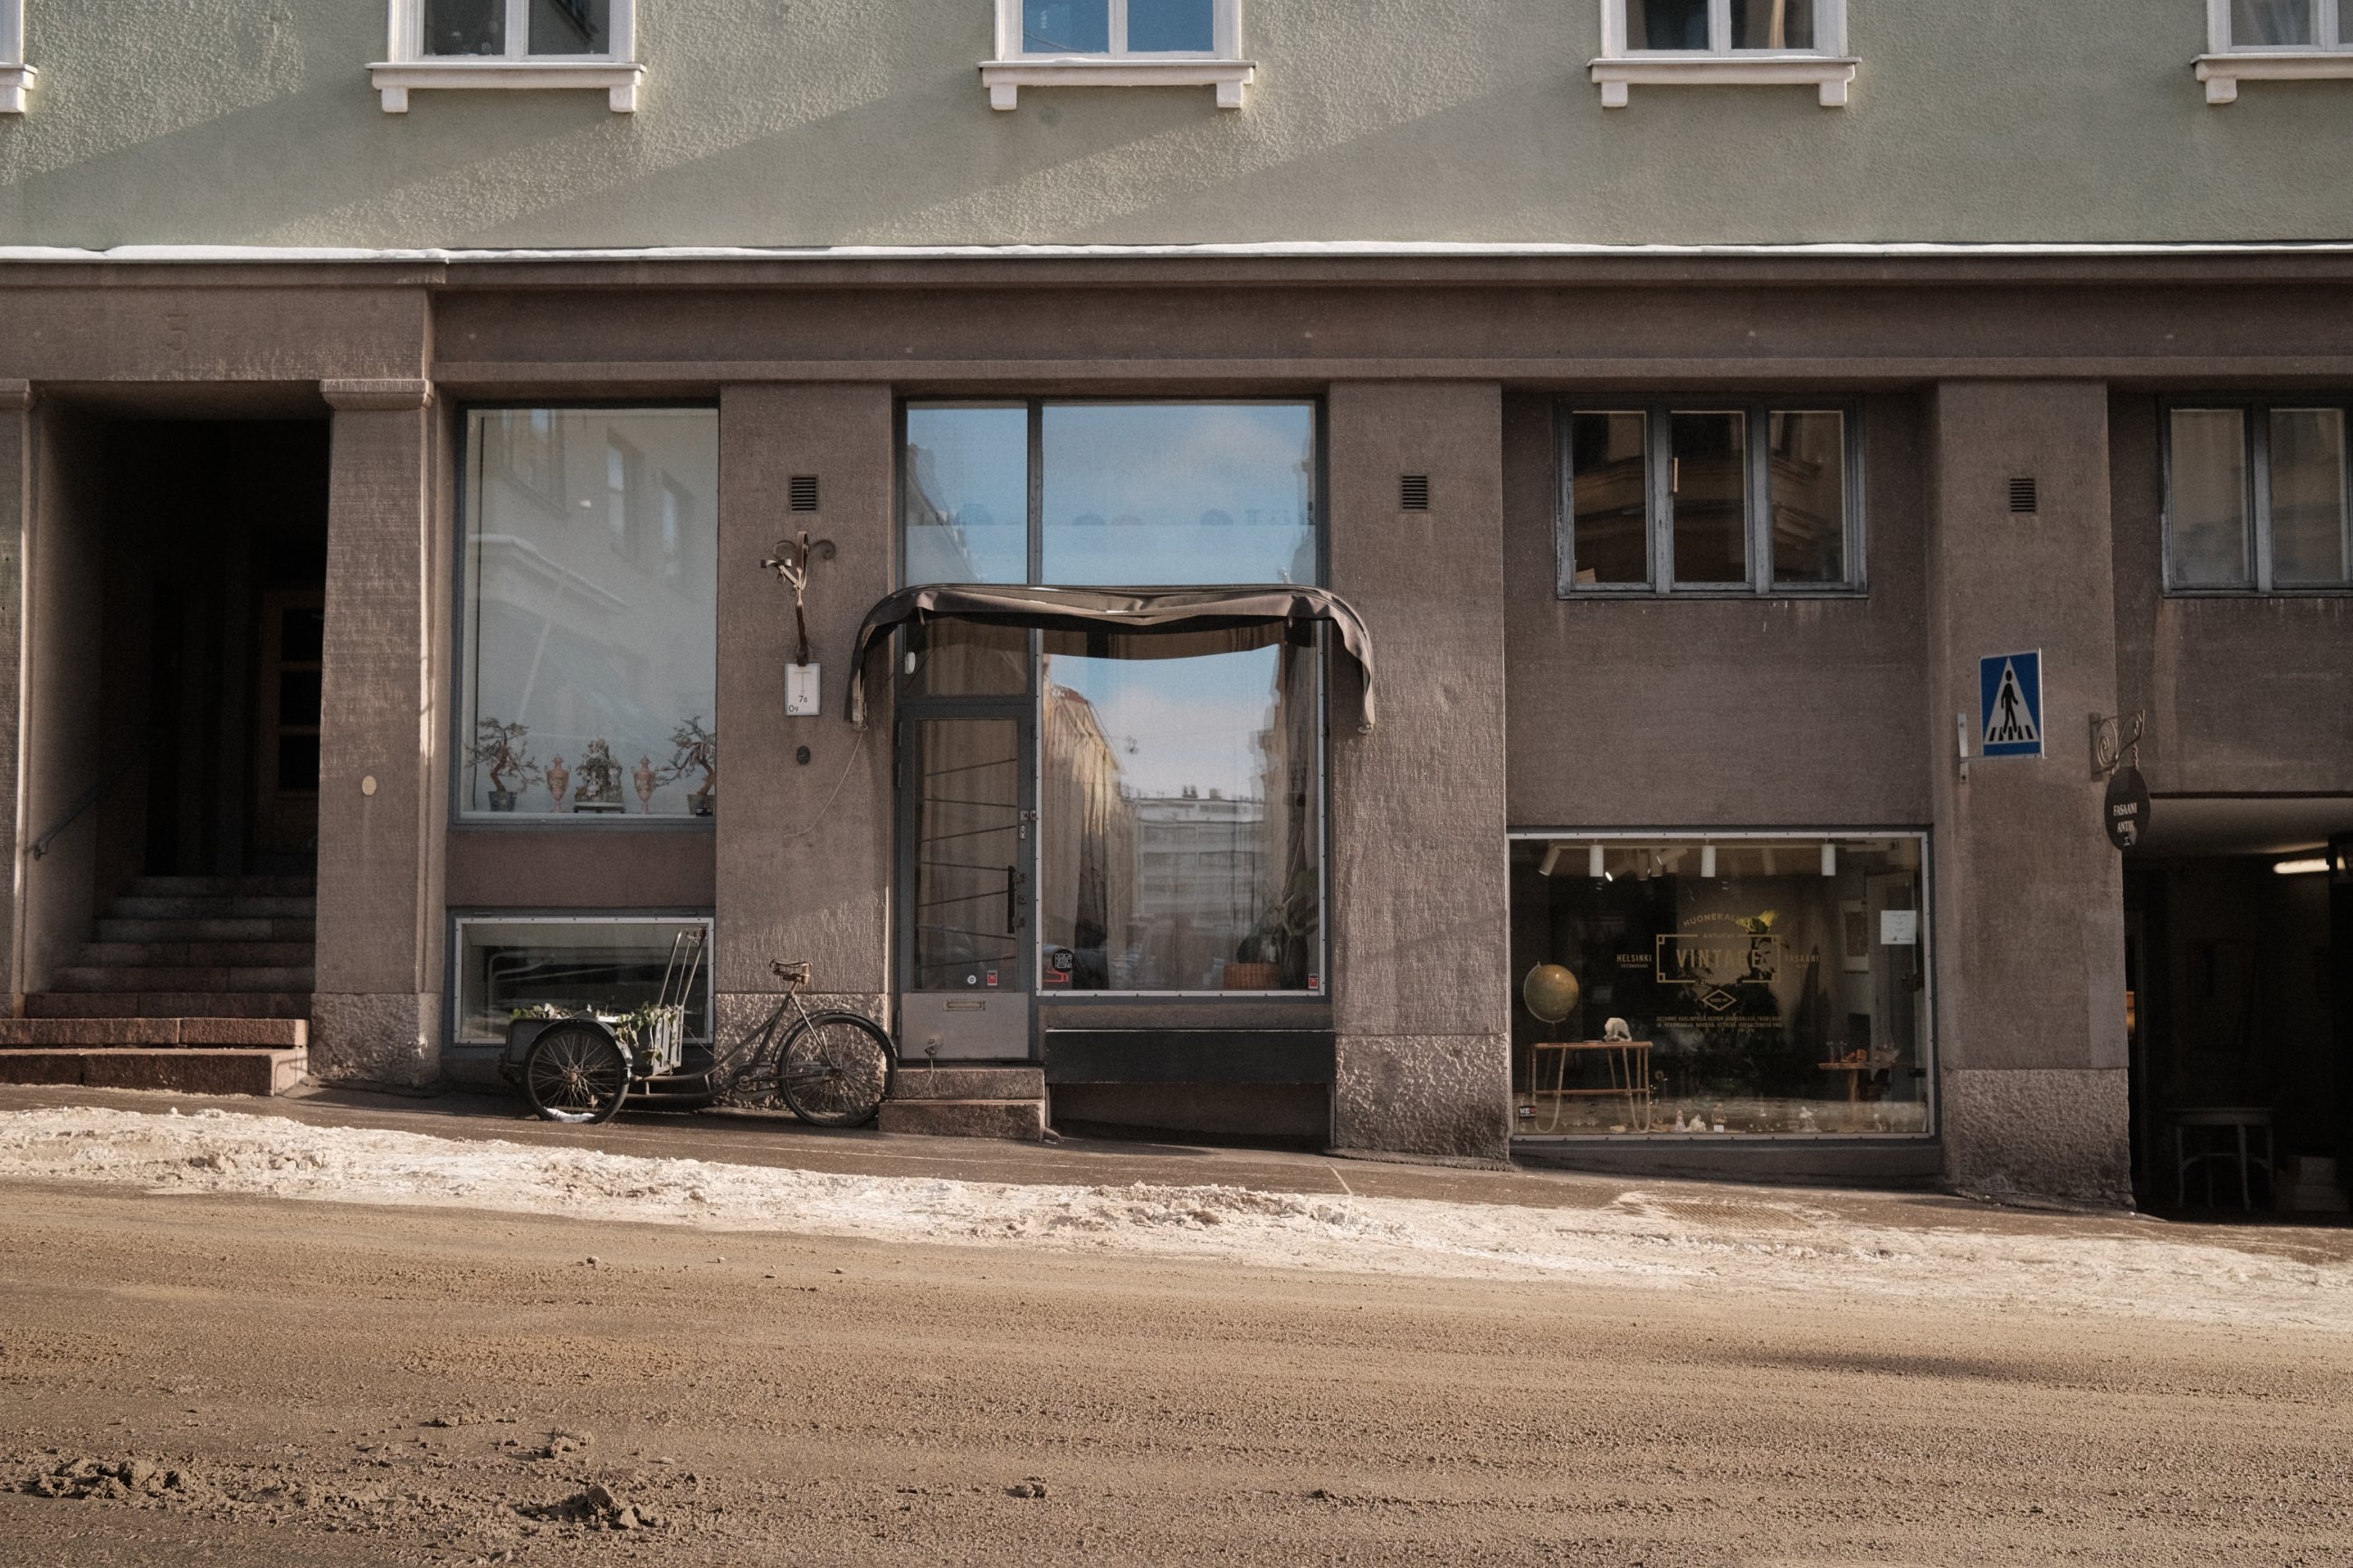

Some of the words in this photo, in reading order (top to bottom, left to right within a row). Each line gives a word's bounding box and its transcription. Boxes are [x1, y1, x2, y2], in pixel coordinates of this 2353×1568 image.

[2113, 803, 2138, 816] FASAANI
[1616, 954, 1652, 963] HELSINKI
[1676, 949, 1760, 968] VINTAGE
